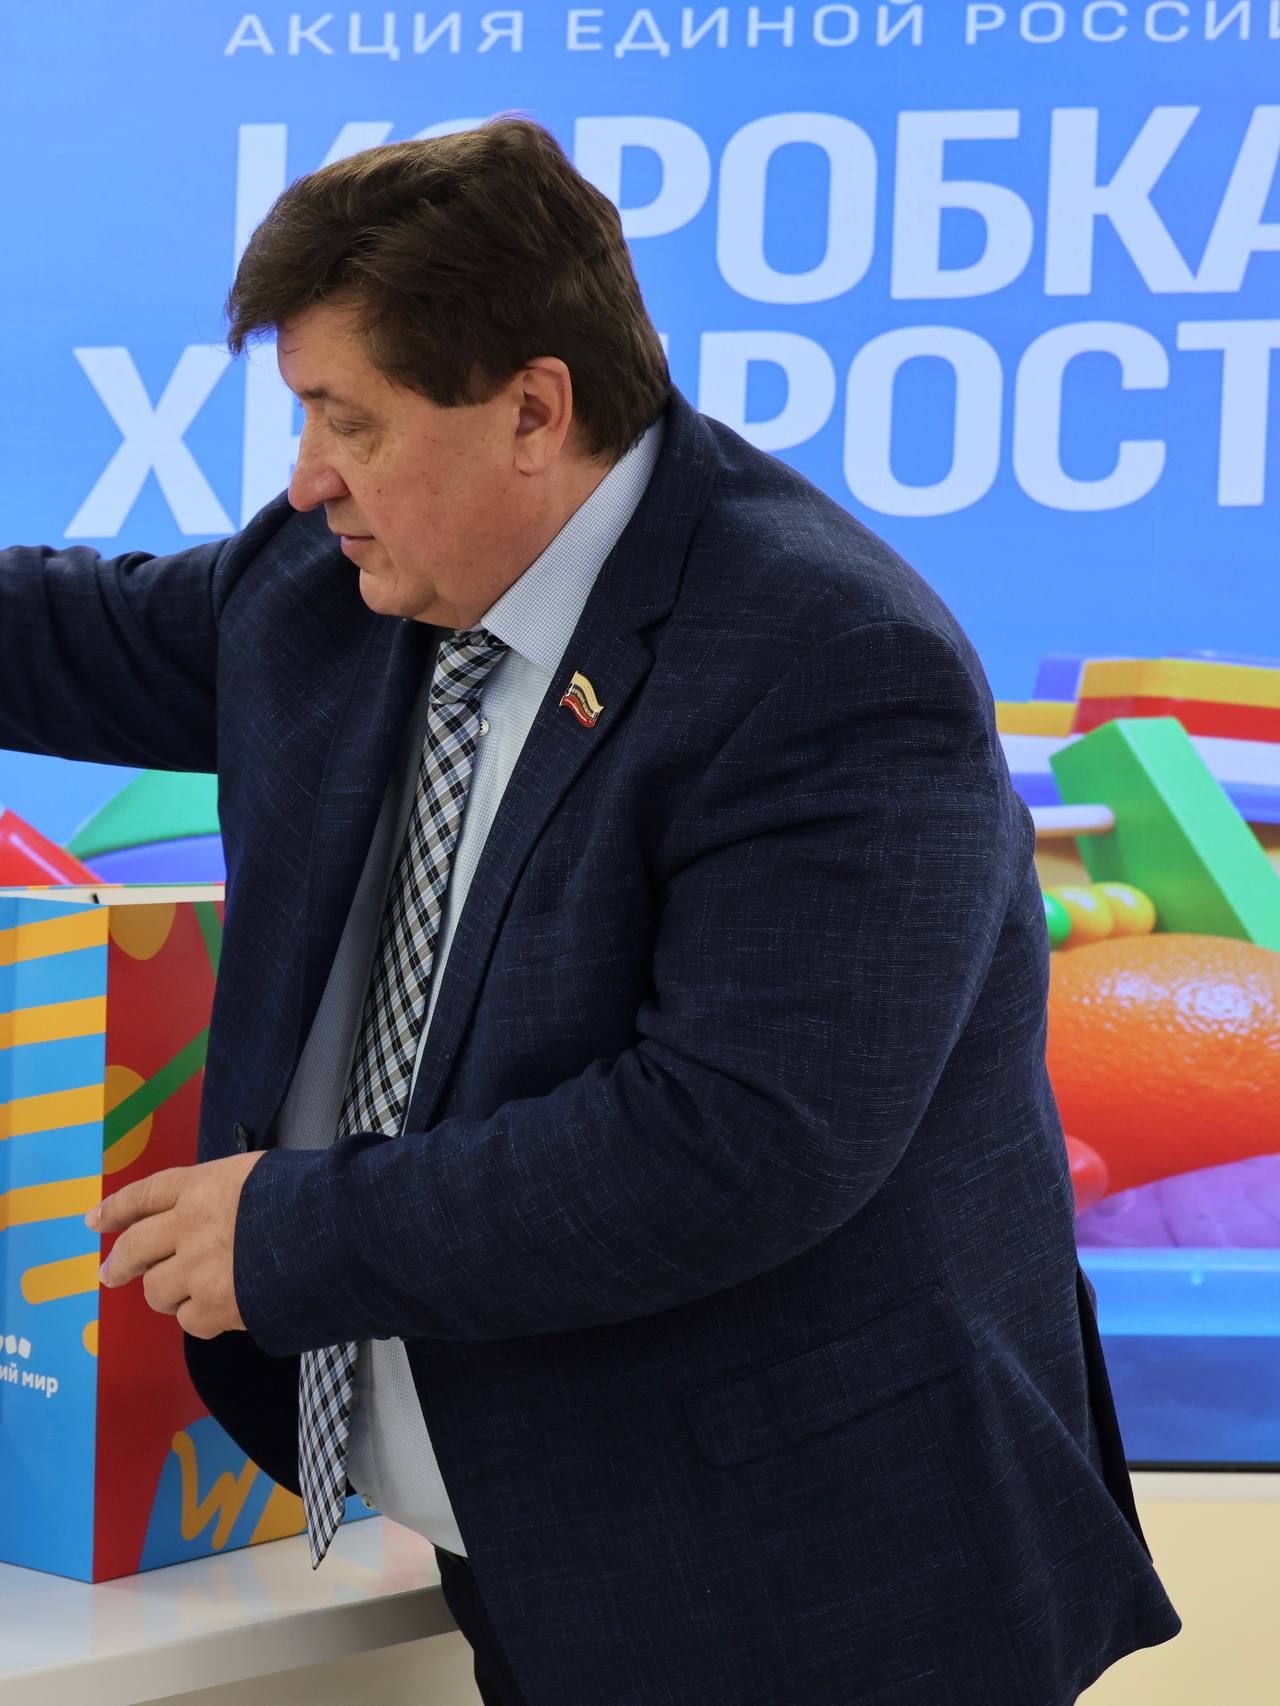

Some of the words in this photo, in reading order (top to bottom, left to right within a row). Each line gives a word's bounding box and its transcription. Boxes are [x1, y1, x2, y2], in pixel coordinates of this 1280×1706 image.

[224, 10, 524, 61] АКЦИЯ
[567, 0, 923, 57] ЕДИНОЙ
[965, 0, 1280, 45] РОССИ
[233, 105, 1280, 304] РОБК
[22, 1371, 59, 1399] мир
